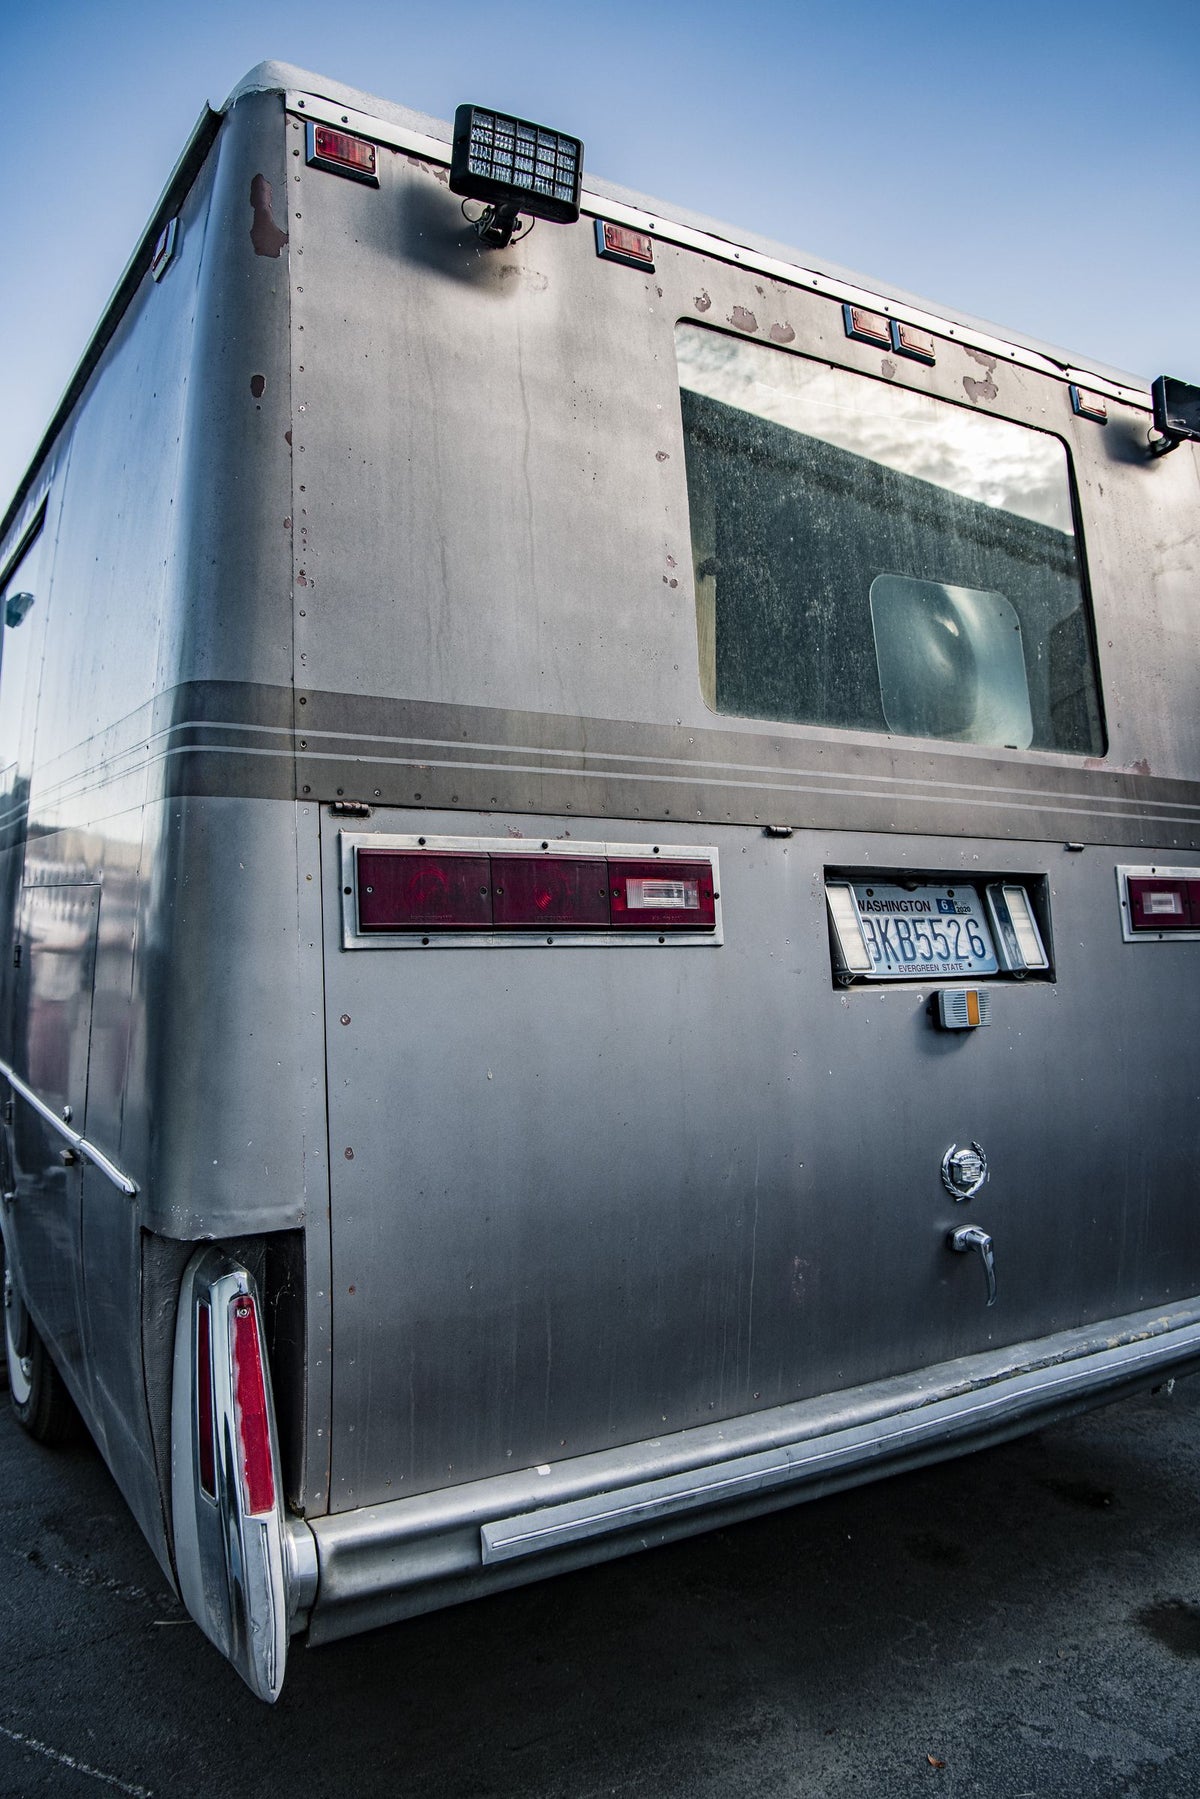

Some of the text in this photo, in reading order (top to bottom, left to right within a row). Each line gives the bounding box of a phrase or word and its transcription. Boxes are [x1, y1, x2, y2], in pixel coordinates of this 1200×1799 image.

[941, 900, 949, 910] 6
[898, 962, 964, 973] EVERGREEN STATE
